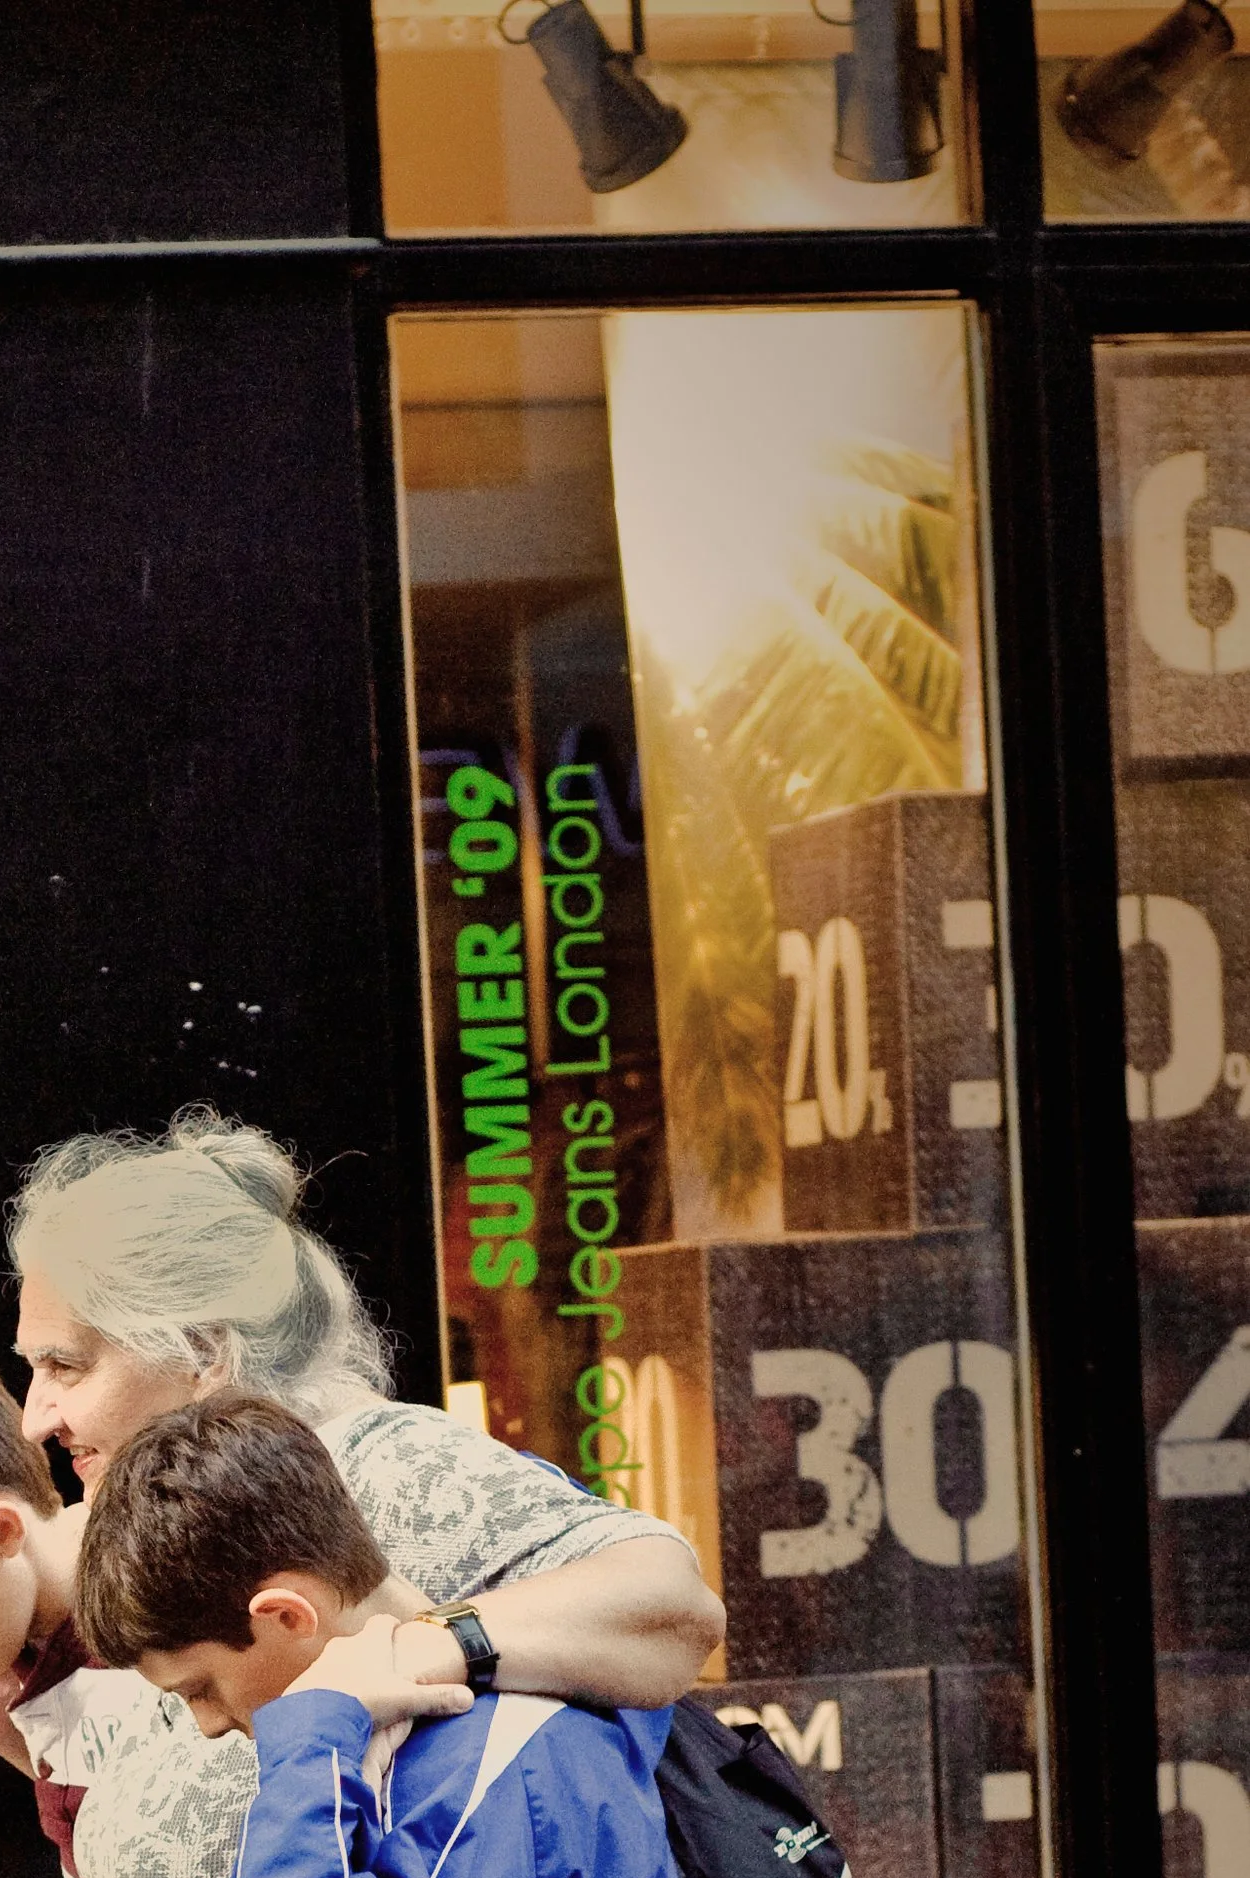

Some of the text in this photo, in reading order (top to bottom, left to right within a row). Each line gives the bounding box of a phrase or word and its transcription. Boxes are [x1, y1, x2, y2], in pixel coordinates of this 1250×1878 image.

[541, 764, 612, 1075] London
[455, 921, 539, 1289] SUMMER
[556, 1100, 625, 1341] Jeans
